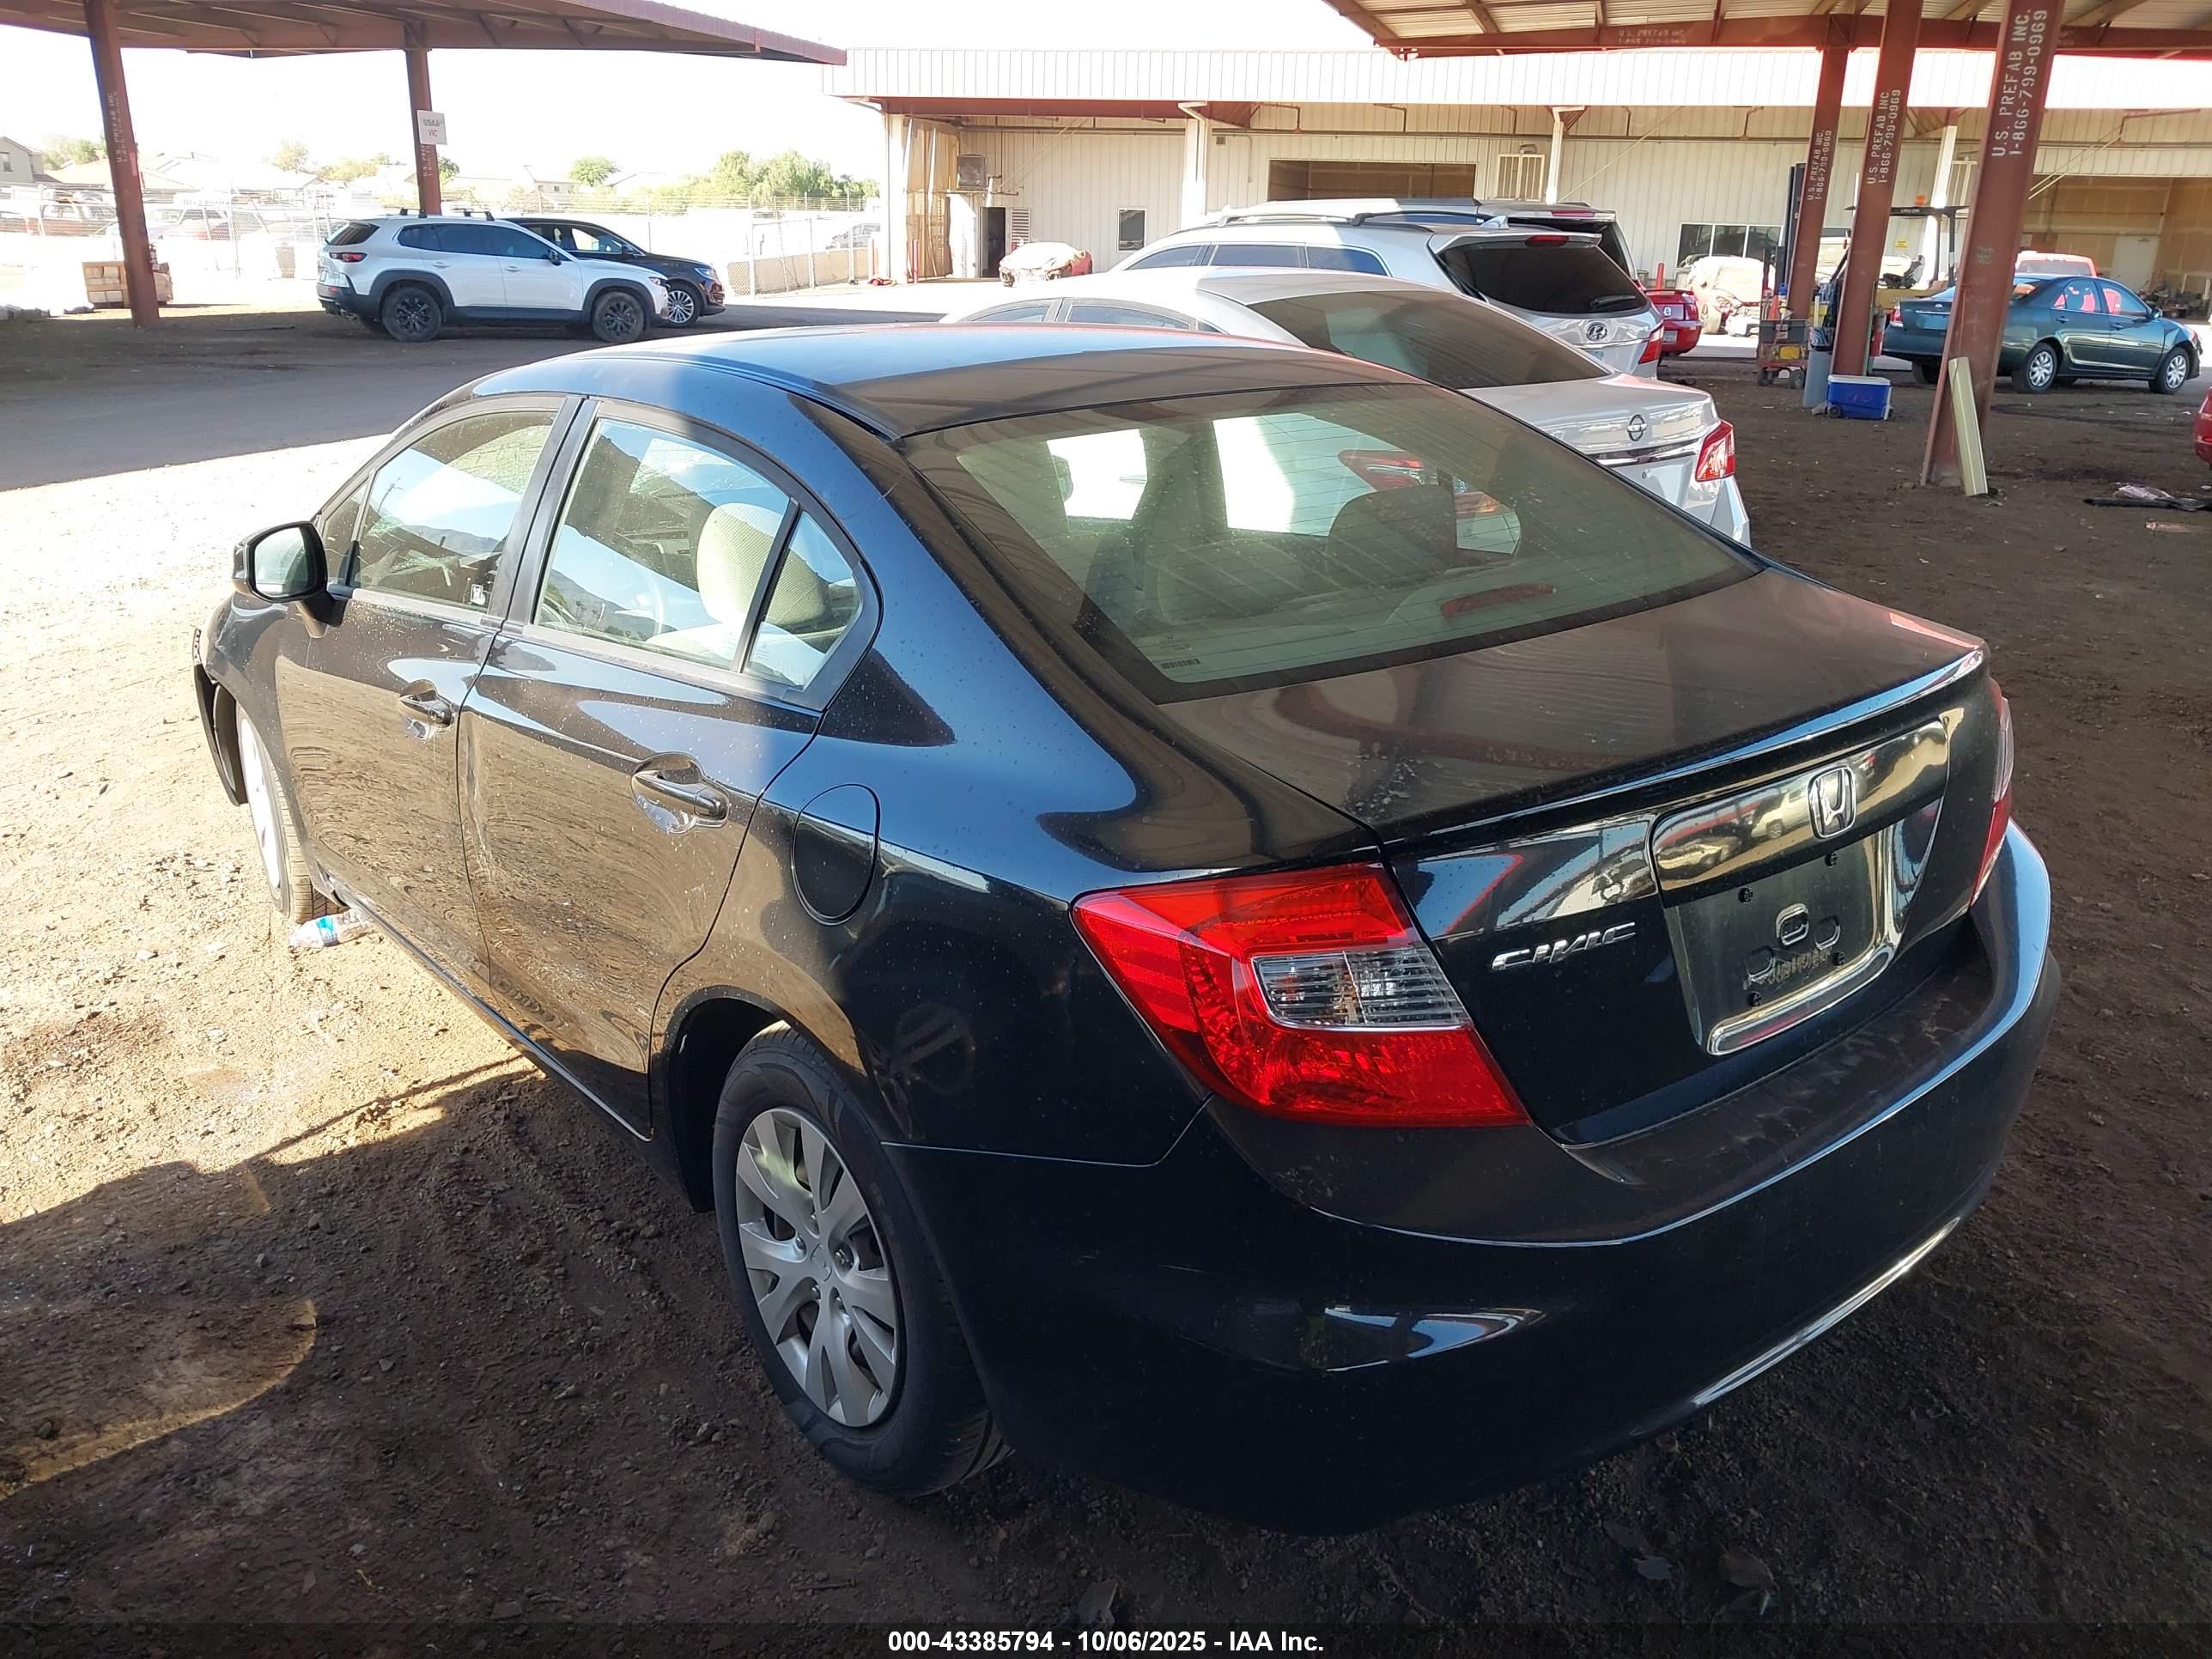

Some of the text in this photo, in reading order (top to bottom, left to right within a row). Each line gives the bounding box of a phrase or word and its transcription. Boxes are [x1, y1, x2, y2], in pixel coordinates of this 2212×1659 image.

[1992, 9, 2032, 156] U.S. PREFAB INC.
[2009, 9, 2048, 155] 1-866-799-0969
[1871, 115, 1886, 157] PREFAB
[1809, 149, 1821, 181] PREFAB
[1490, 921, 1638, 971] CIVIC
